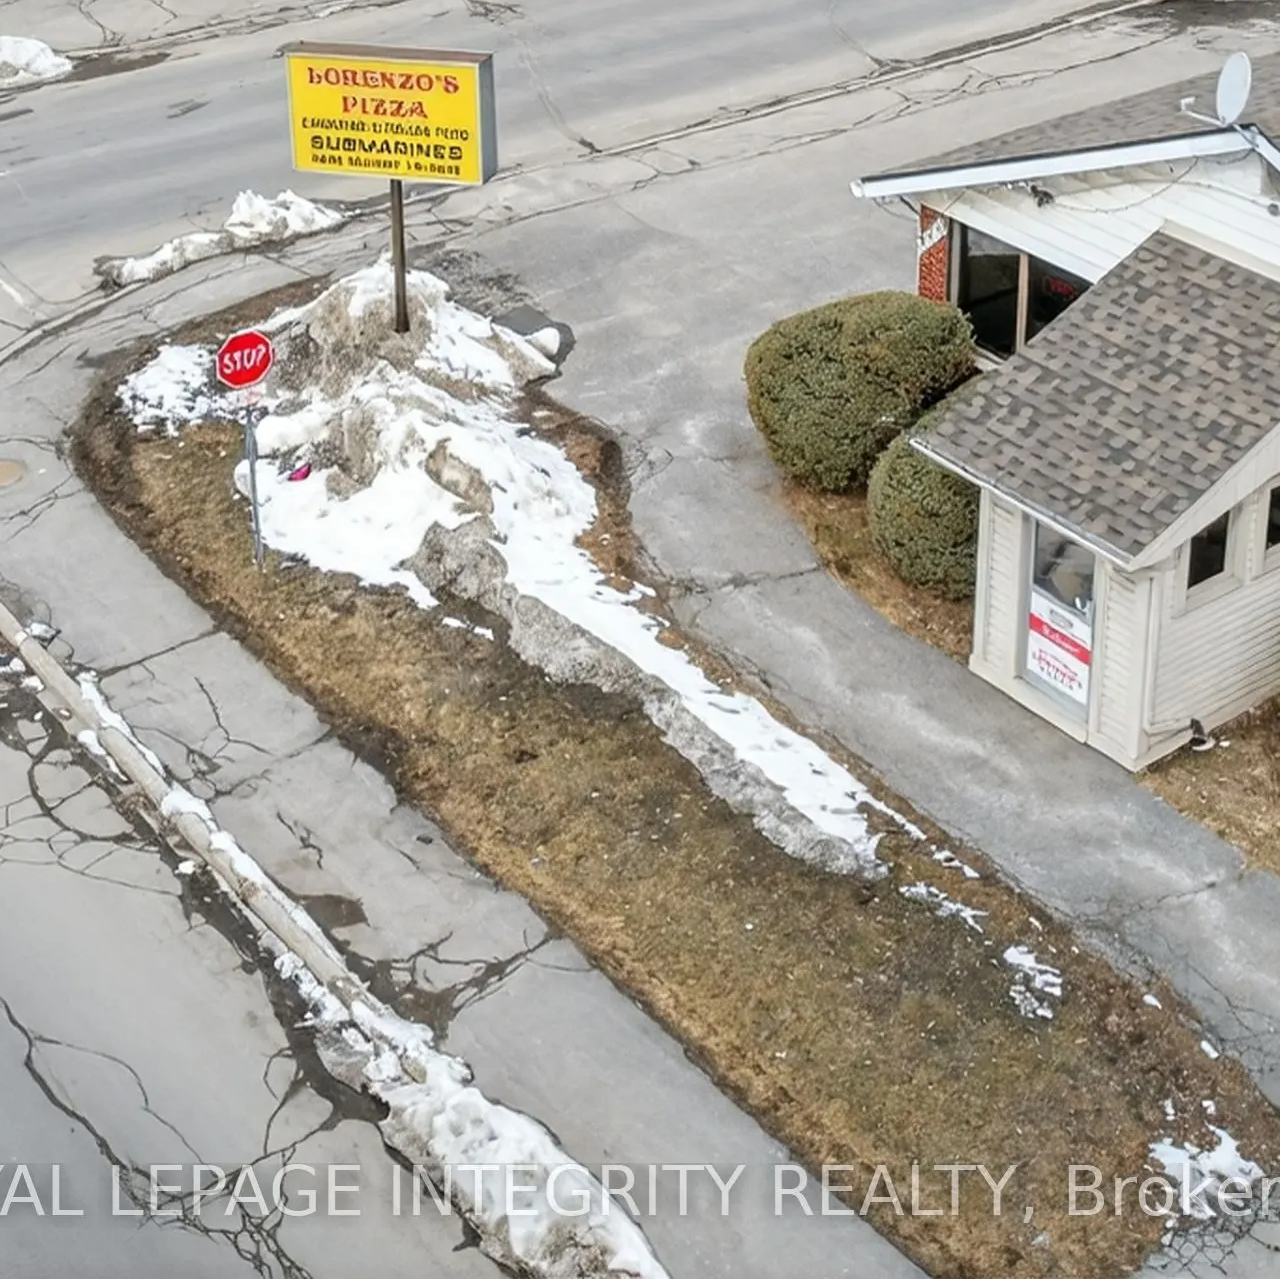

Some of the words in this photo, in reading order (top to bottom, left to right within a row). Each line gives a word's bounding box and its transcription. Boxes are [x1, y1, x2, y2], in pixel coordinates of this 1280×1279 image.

[308, 67, 460, 94] LORENZO'S
[341, 95, 428, 119] PIZZA
[222, 343, 267, 375] STOP
